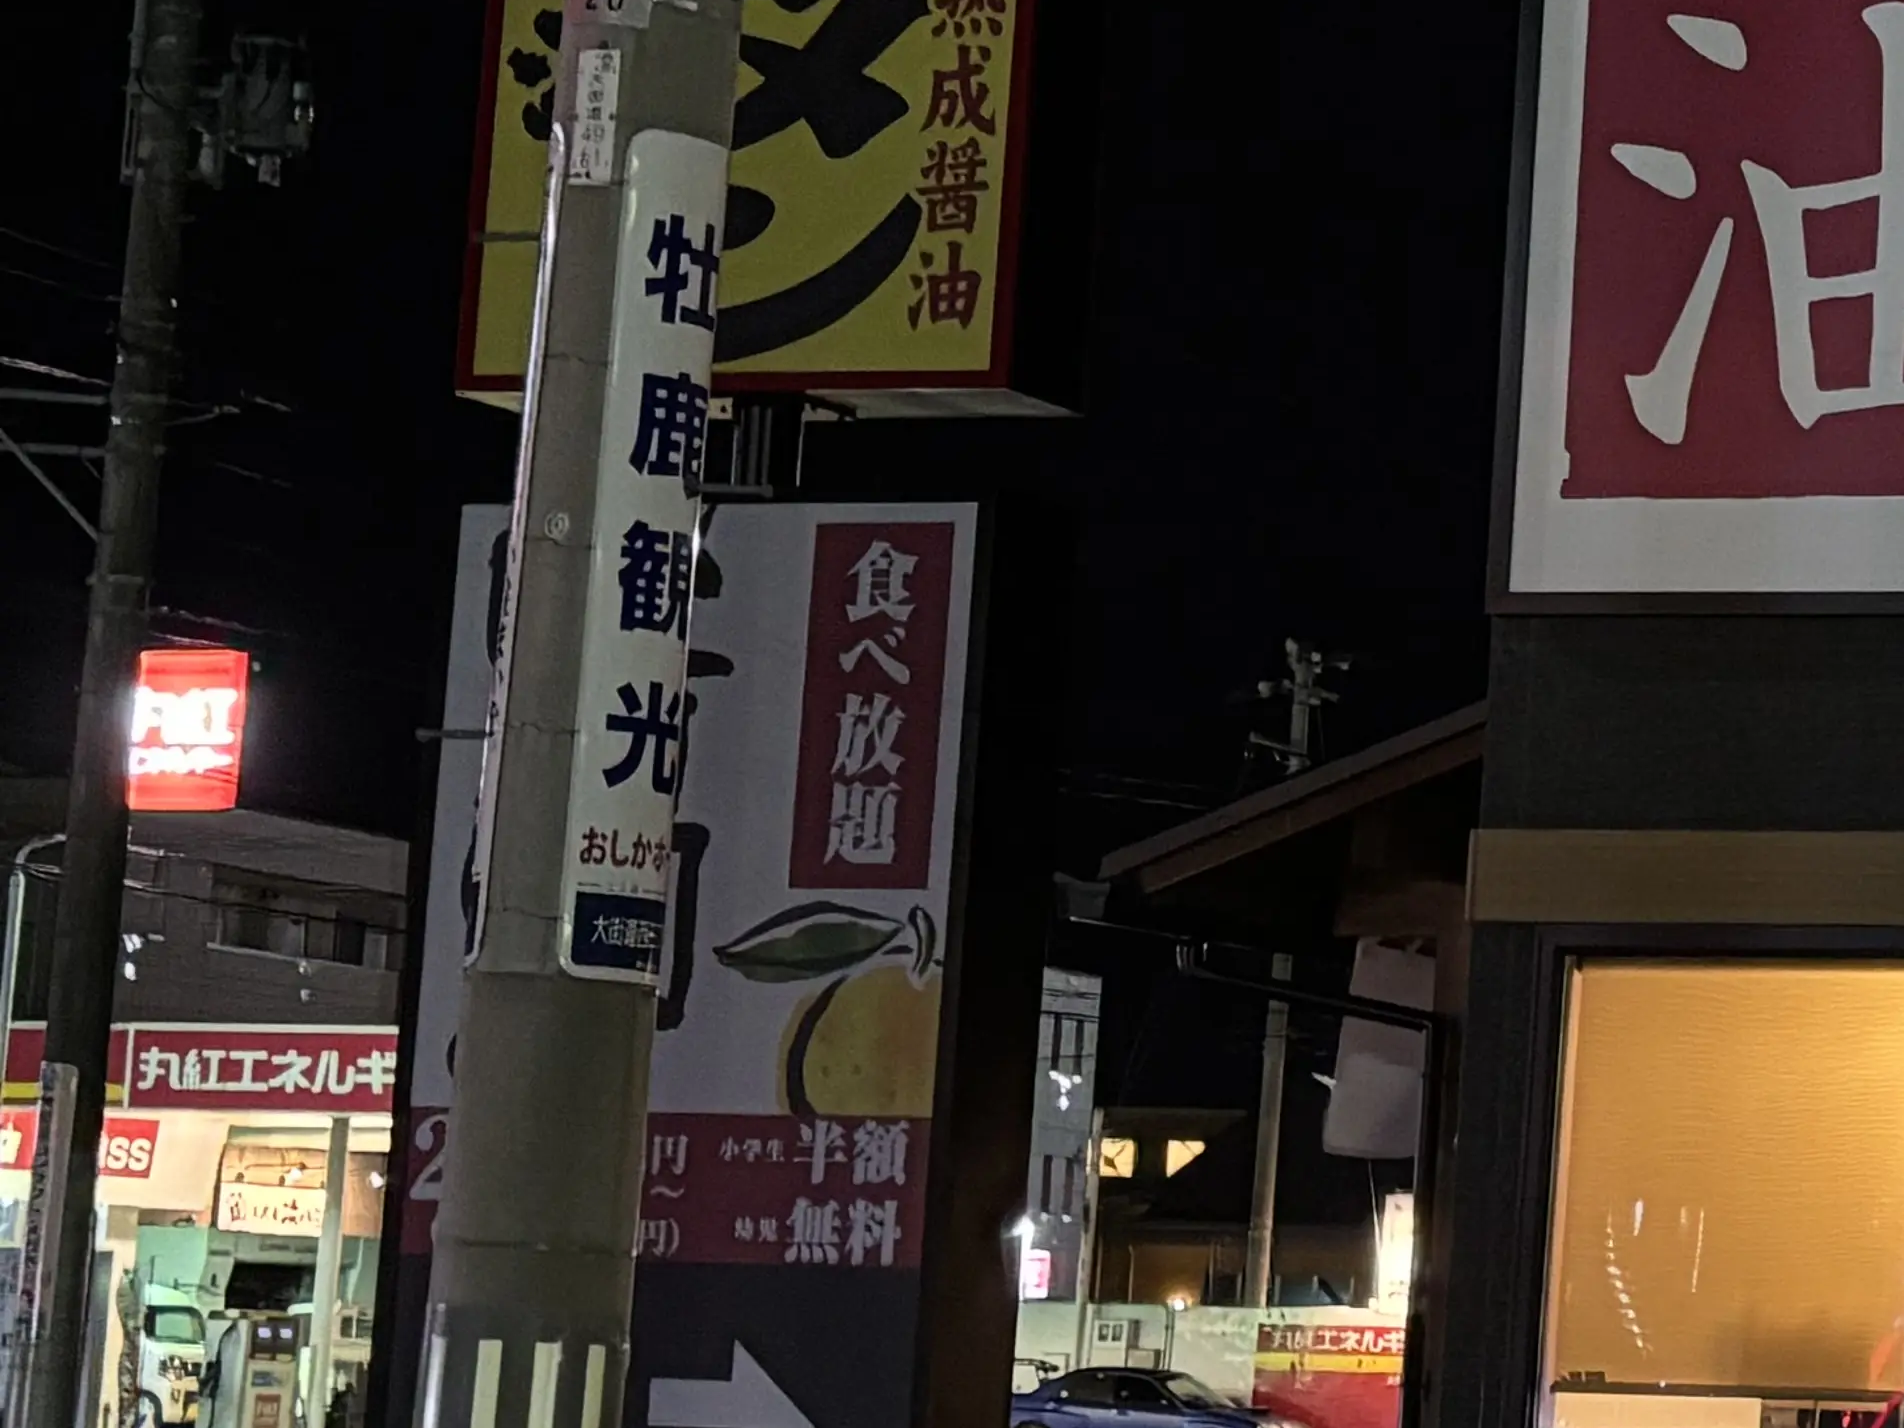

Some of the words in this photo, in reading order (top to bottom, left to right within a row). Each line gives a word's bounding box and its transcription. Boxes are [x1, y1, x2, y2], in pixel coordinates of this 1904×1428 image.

[602, 213, 721, 796] 牡鹿観光
[823, 540, 920, 865] 食べ放題
[137, 1046, 397, 1095] 丸紅エネルギ
[793, 1118, 910, 1185] 半額
[784, 1196, 902, 1267] 無料
